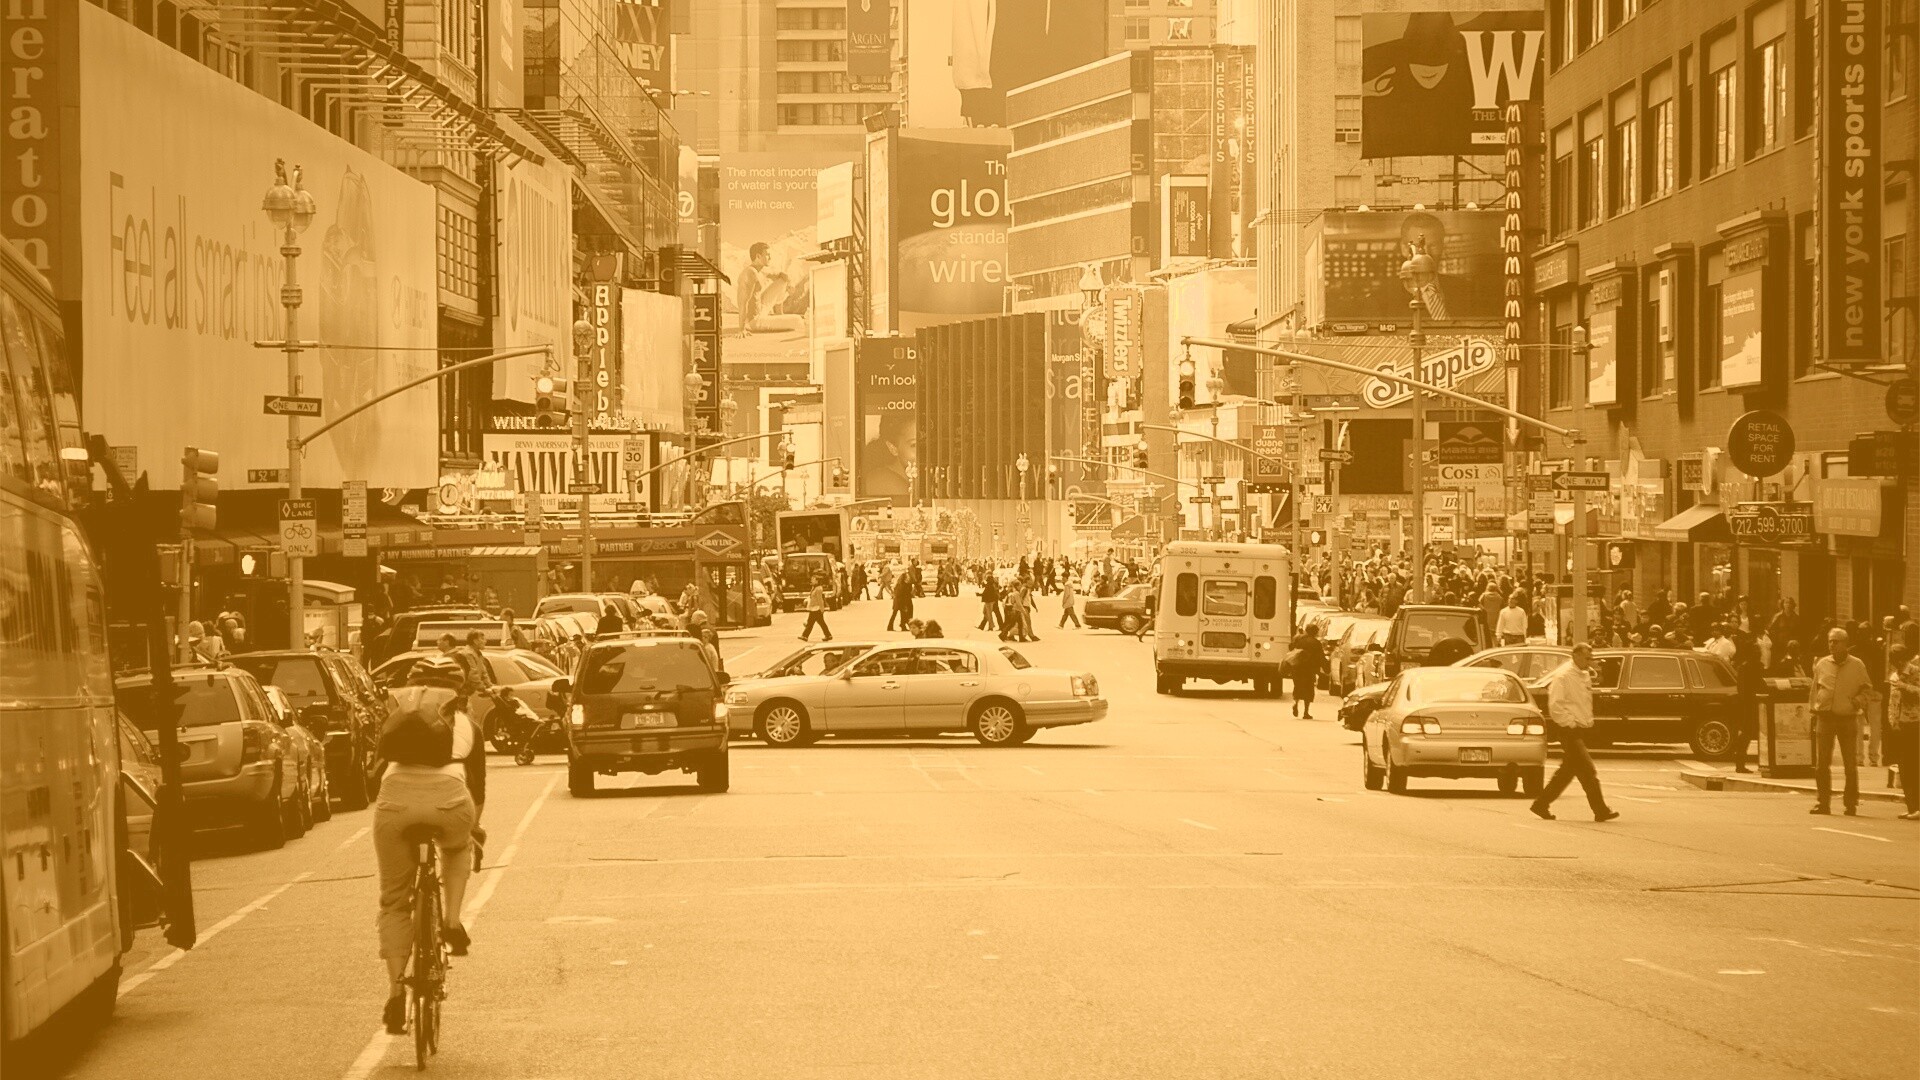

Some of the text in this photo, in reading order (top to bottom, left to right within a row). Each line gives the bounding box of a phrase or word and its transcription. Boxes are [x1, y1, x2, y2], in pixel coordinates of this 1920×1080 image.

[850, 31, 887, 45] ARGENT
[1472, 110, 1496, 121] THE
[726, 166, 746, 178] The
[749, 167, 776, 178] most
[984, 159, 1008, 175] Th
[1840, 0, 1871, 348] new york sports clu
[727, 180, 738, 191] of
[740, 180, 771, 191] water
[772, 180, 782, 191] is
[784, 182, 810, 194] your
[728, 199, 742, 211] Fill
[744, 199, 767, 211] with
[930, 178, 1011, 229] glo
[949, 228, 1007, 245] standa
[109, 170, 157, 326] Feel
[163, 194, 188, 331] all
[194, 224, 248, 342] smart
[252, 219, 287, 342] insi
[1379, 324, 1395, 332] M-121
[1112, 297, 1132, 372] Twizzlers
[1051, 354, 1074, 364] Morgan
[870, 374, 891, 386] I'm
[272, 400, 315, 412] ONE WAY
[1748, 422, 1780, 432] RETAIL
[1255, 439, 1283, 447] duane
[1748, 433, 1780, 443] SPACE
[1255, 447, 1283, 455] reade
[1753, 443, 1774, 452] FOR
[625, 452, 642, 462] 30
[1750, 454, 1776, 463] RENT
[249, 470, 257, 481] W
[259, 470, 268, 482] 52
[1441, 465, 1480, 480] Così
[1560, 477, 1603, 485] ONE WAY
[291, 510, 314, 518] LANE
[1736, 516, 1804, 535] 212.599.3700
[288, 545, 309, 553] ONLY
[600, 542, 634, 552] PARTNER
[387, 551, 400, 560] MY
[401, 550, 436, 559] RUNNING
